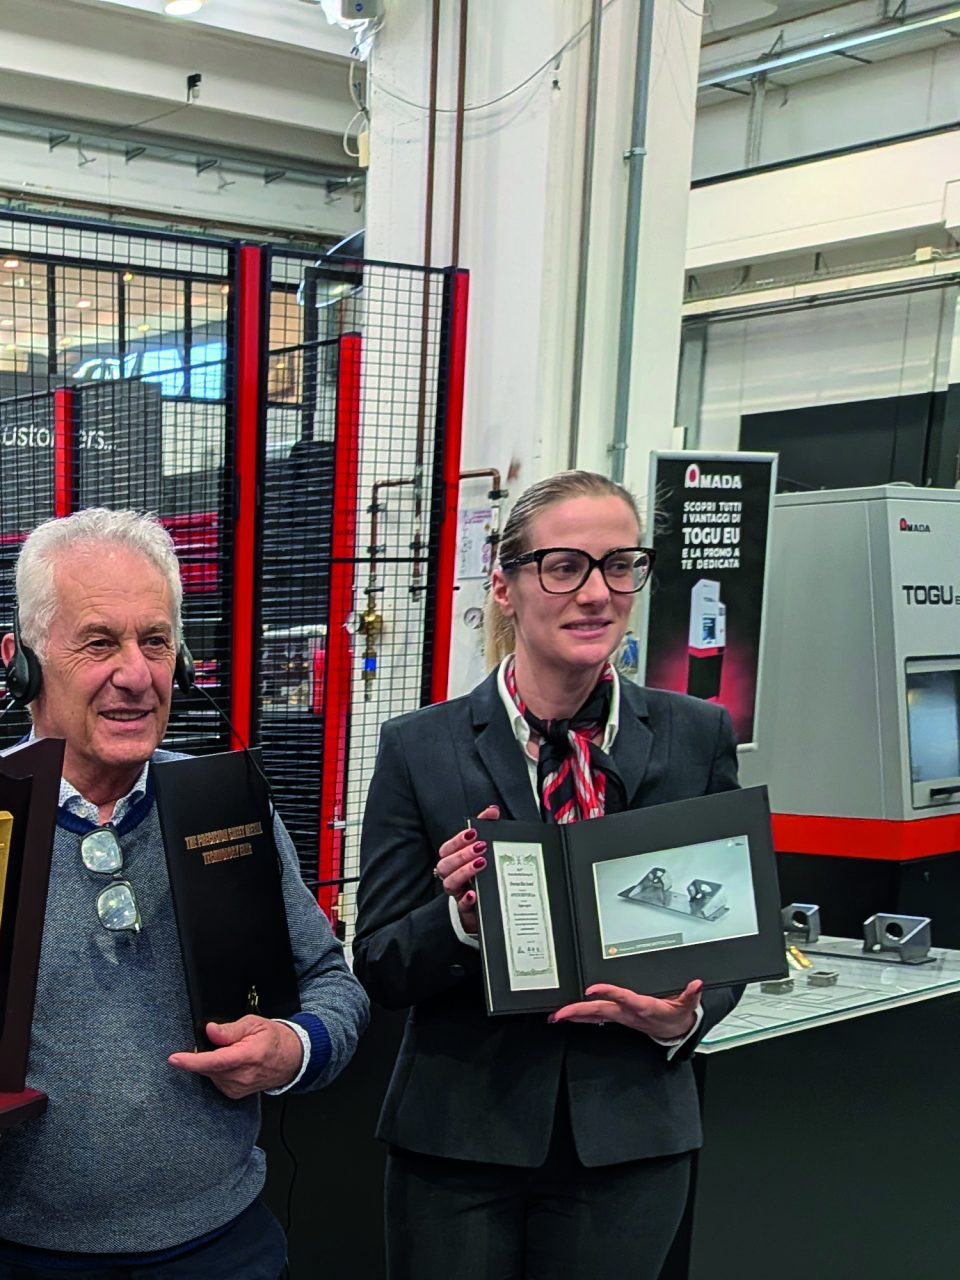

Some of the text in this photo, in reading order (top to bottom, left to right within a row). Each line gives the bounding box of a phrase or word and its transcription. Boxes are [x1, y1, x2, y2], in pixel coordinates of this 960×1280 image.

[684, 463, 742, 489] AMADA
[683, 501, 742, 512] SCOPRI TUTTI
[682, 513, 741, 523] I VANTAGGI DI
[682, 527, 740, 545] TOGU EU
[682, 547, 740, 558] E LA PROMO A
[681, 559, 740, 570] TE DEDICATA
[902, 585, 953, 605] TOGU
